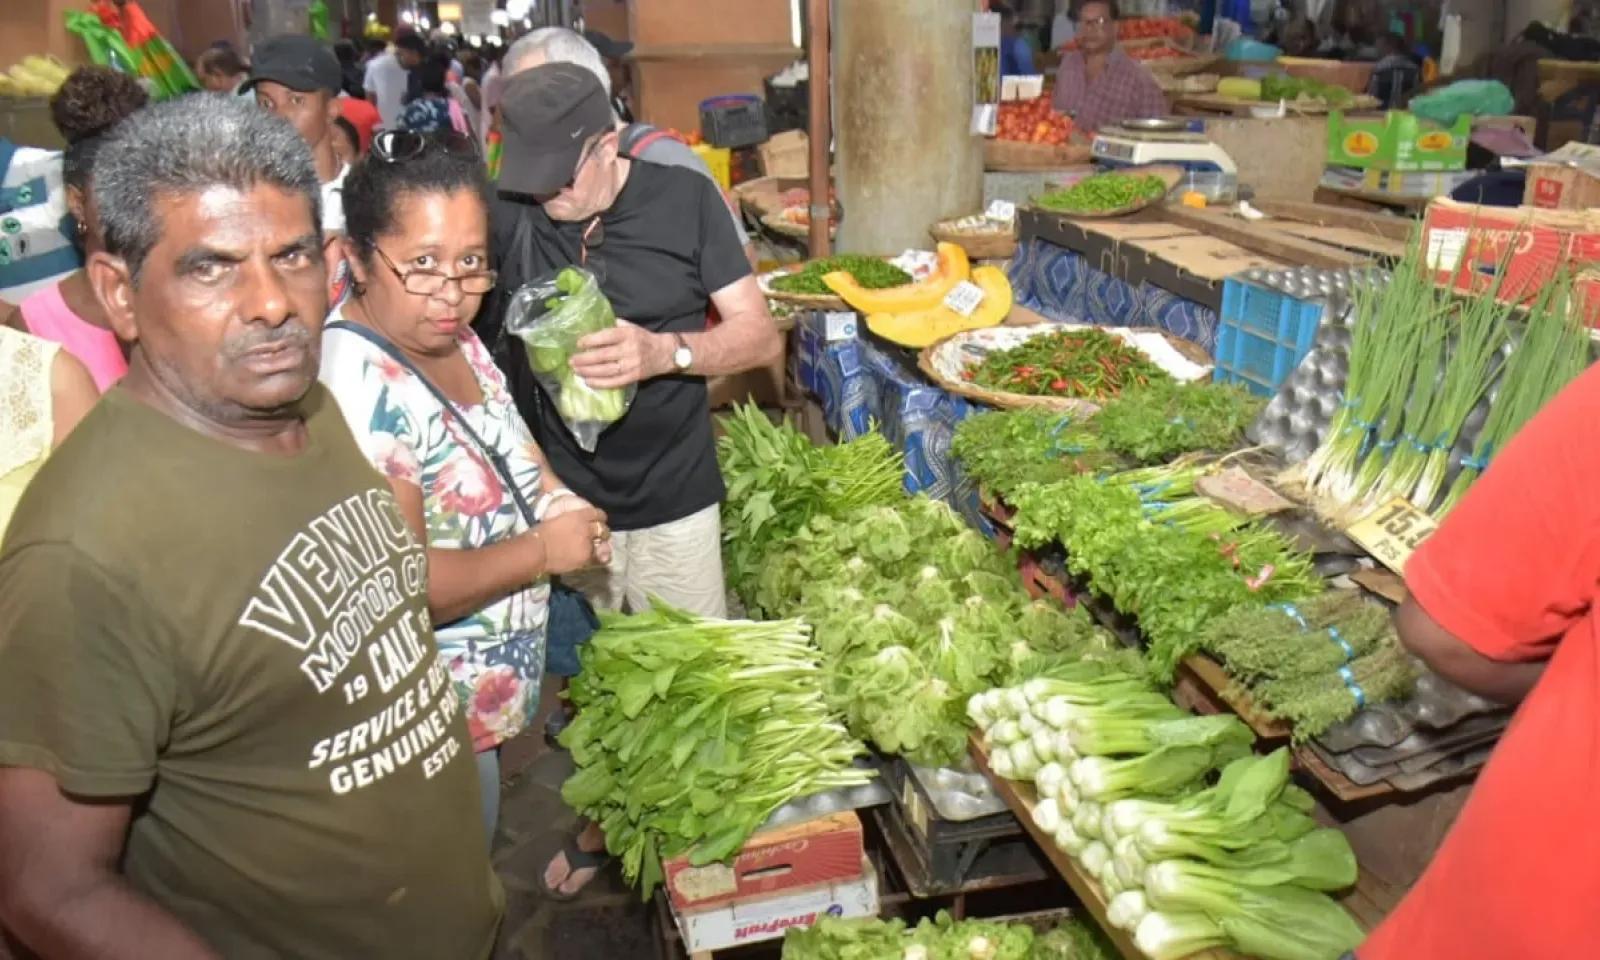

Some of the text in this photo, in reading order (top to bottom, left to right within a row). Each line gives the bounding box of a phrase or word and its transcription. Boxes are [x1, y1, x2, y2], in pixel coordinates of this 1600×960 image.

[239, 488, 423, 650] VENIC
[301, 566, 404, 694] MOTOR
[342, 673, 369, 704] 19
[368, 610, 427, 694] CALIF.
[308, 688, 416, 769] SERVICE
[418, 678, 430, 709] &
[329, 709, 446, 795] GENUINE
